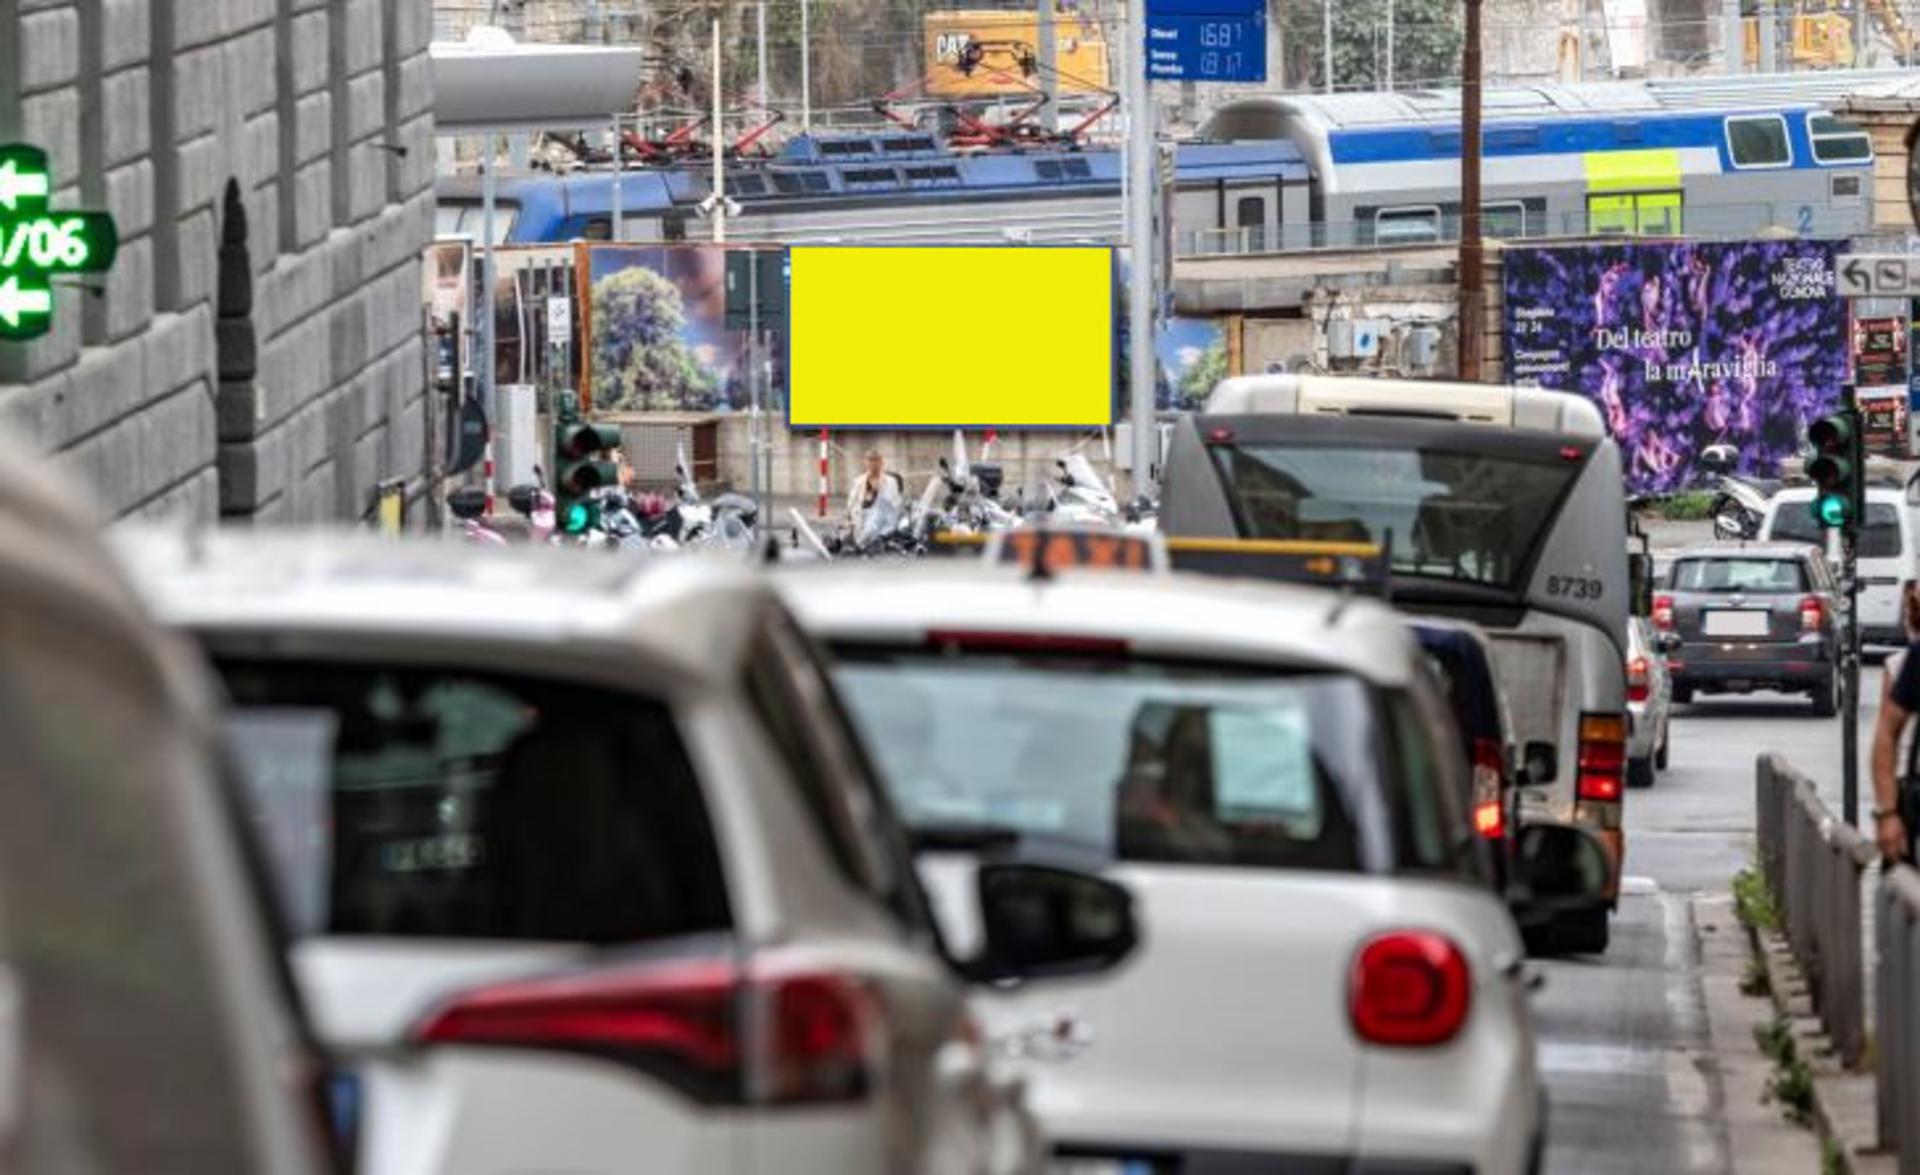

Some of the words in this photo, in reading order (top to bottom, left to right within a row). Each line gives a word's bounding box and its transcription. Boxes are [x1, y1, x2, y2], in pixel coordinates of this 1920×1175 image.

[1797, 206, 1813, 232] 2
[1596, 326, 1629, 350] Del
[1633, 328, 1692, 348] teatro
[1644, 359, 1661, 381] la
[1012, 531, 1143, 572] TAXI
[1546, 575, 1603, 600] 8739
